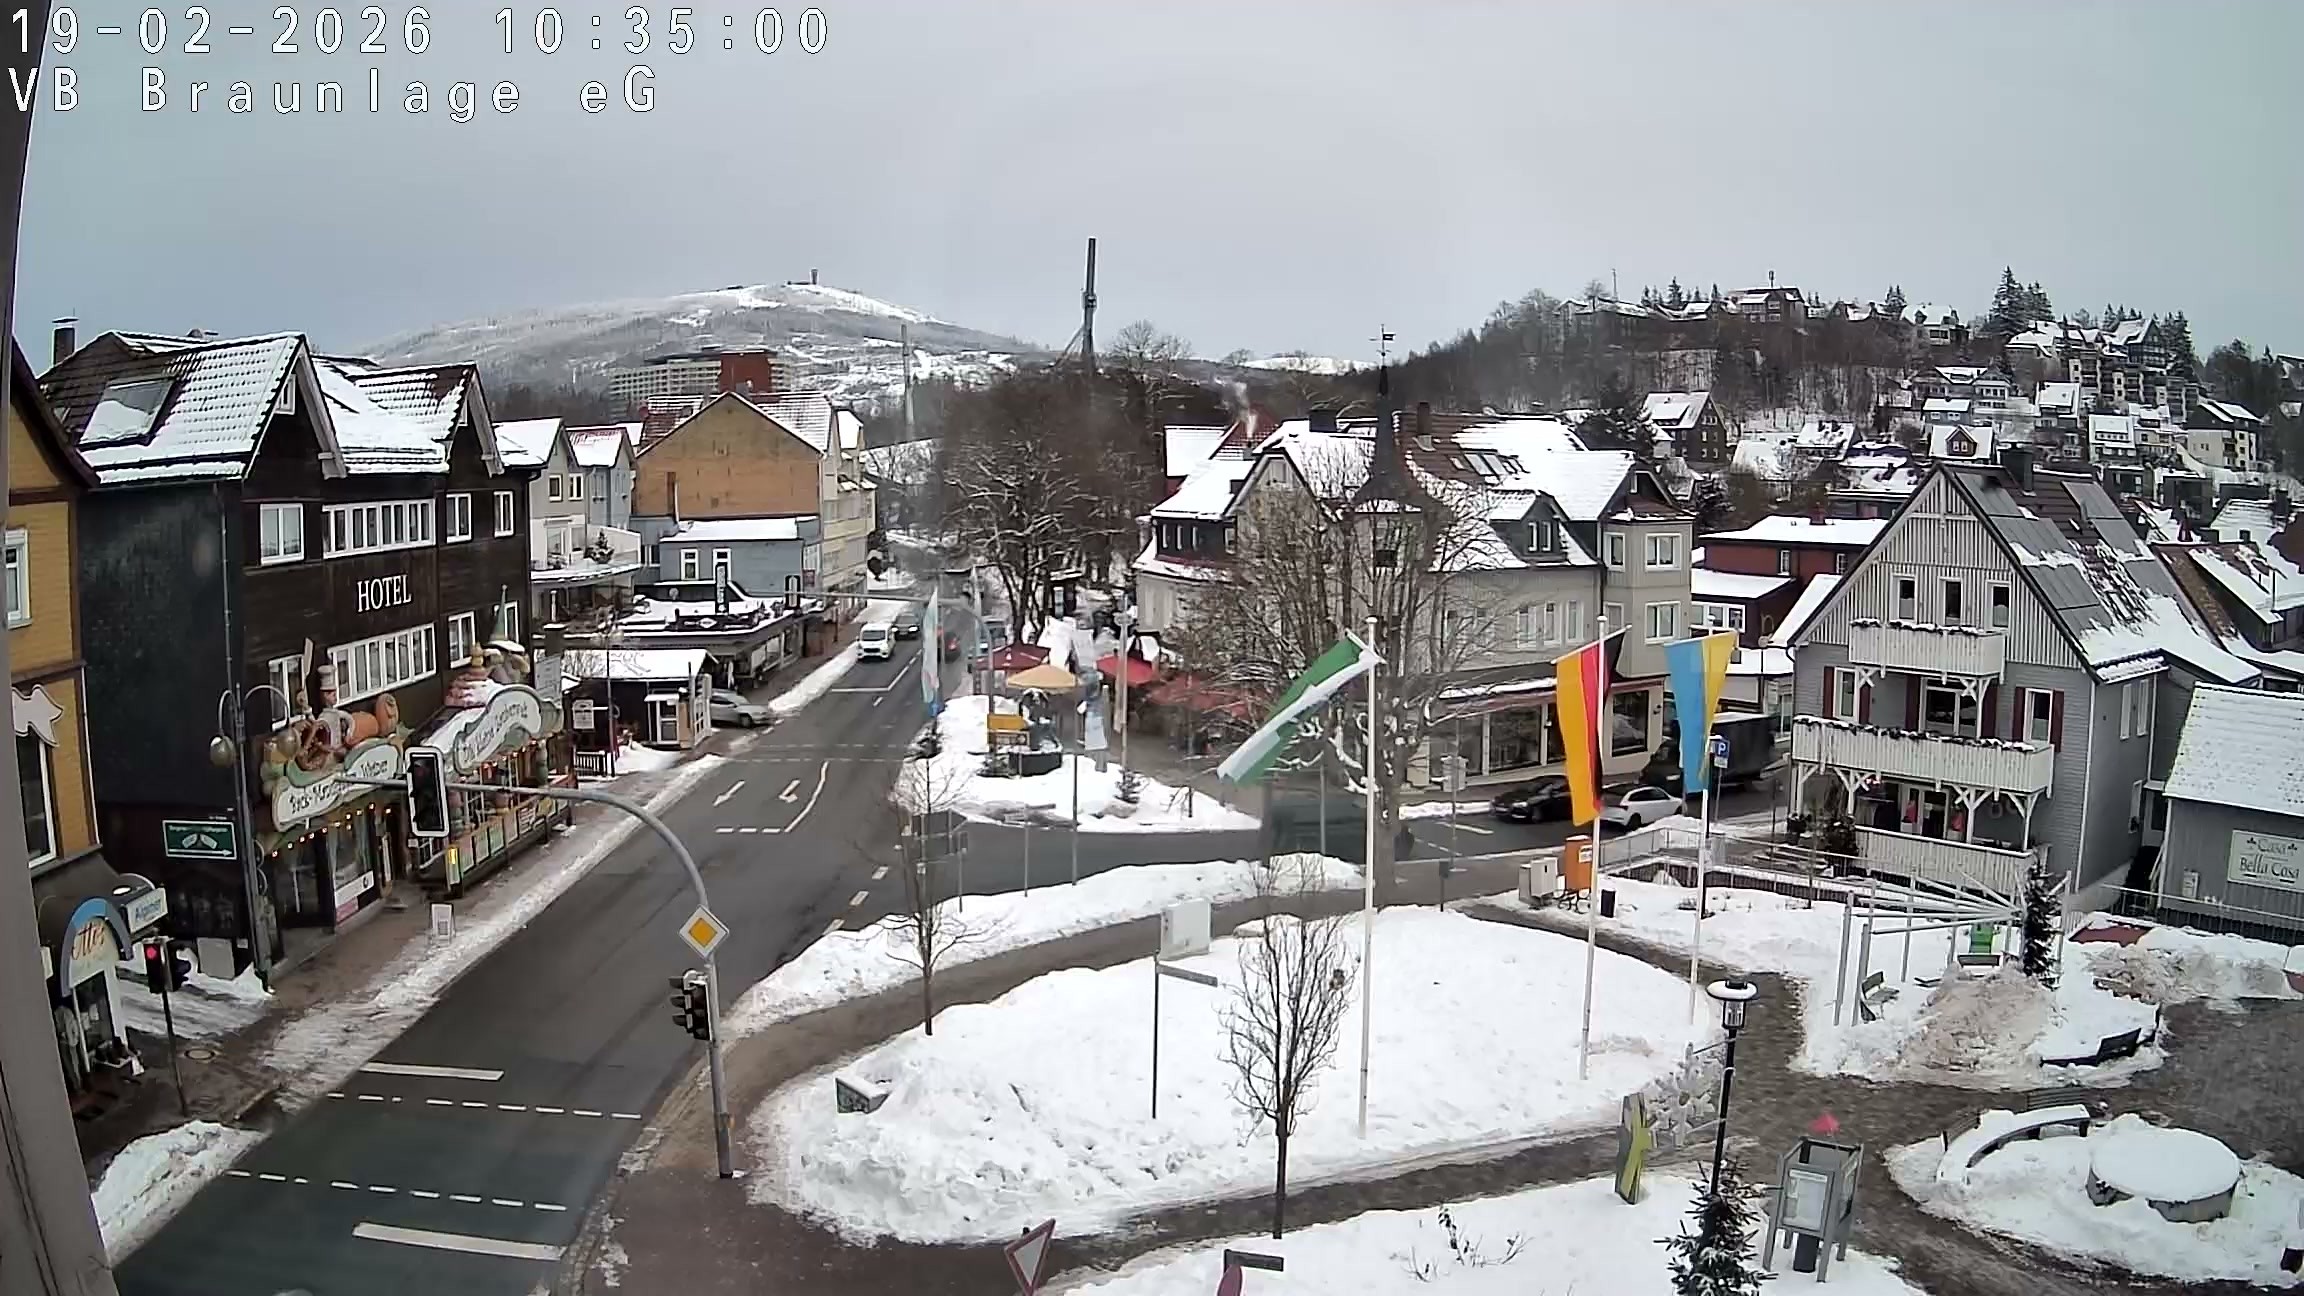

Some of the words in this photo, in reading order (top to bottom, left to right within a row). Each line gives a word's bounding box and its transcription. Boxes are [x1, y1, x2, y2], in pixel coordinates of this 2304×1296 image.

[357, 575, 412, 612] HOTEL
[2240, 854, 2269, 874] Bella
[2271, 863, 2300, 879] Casa
